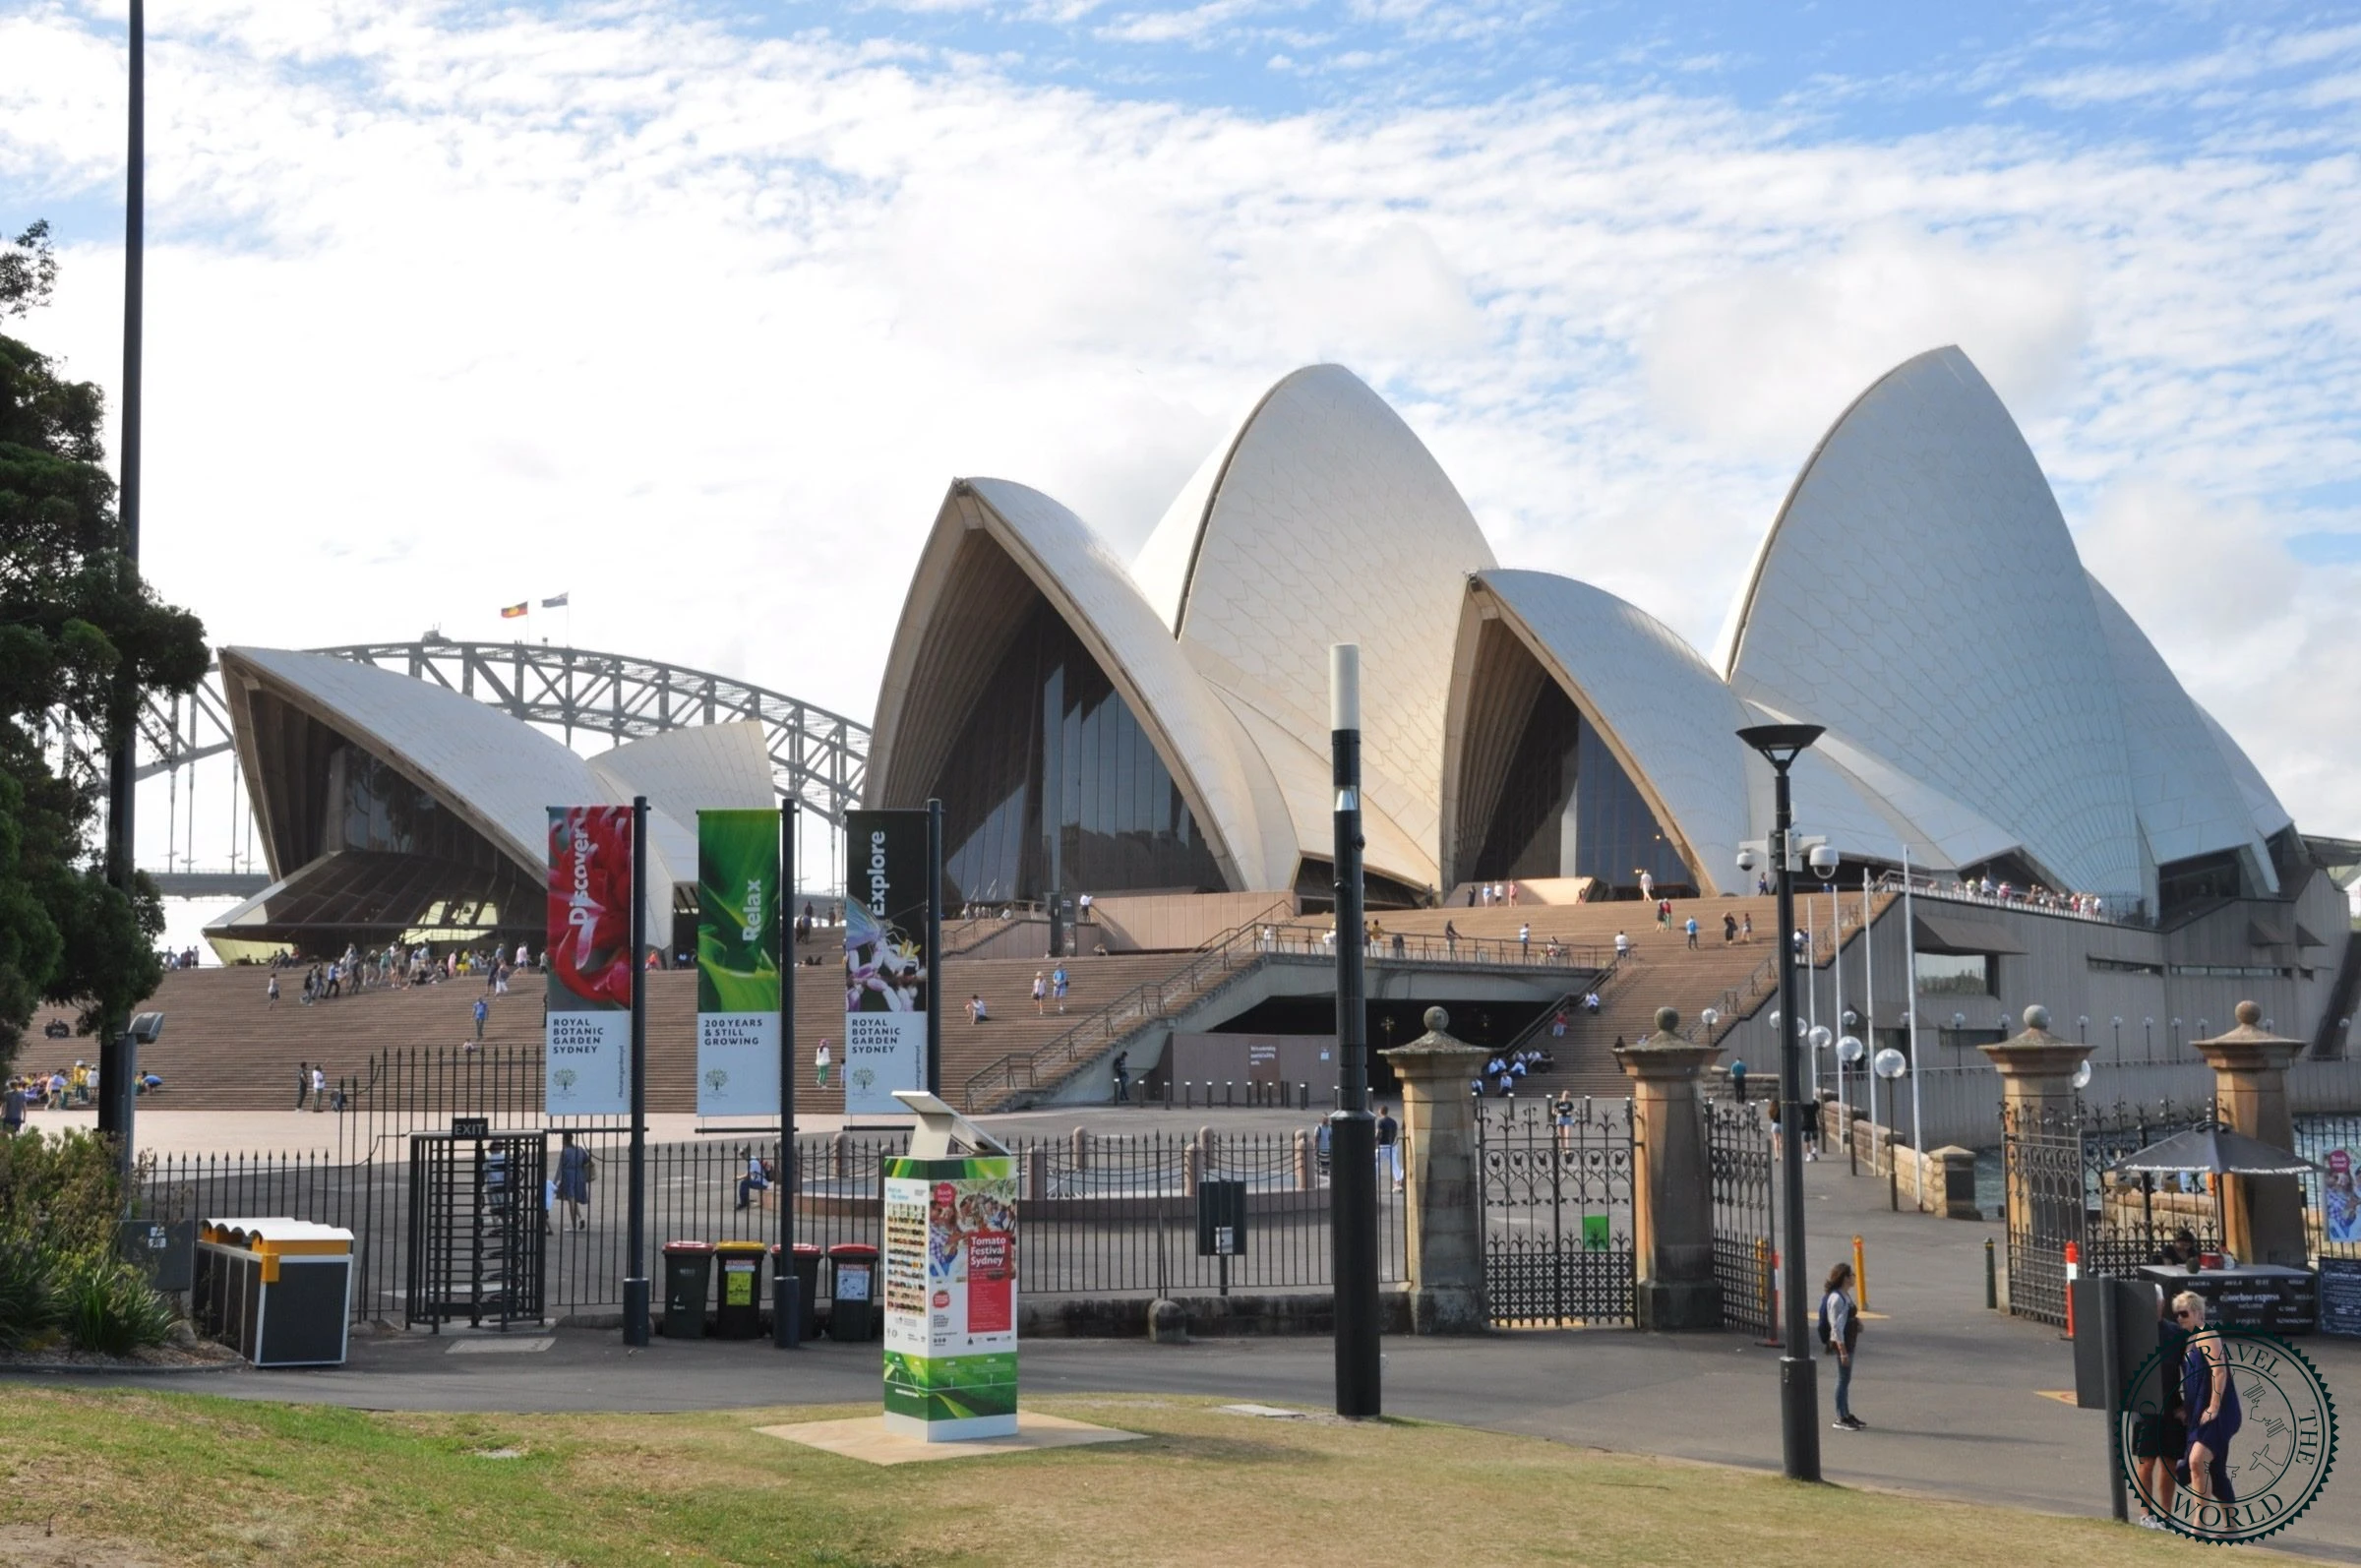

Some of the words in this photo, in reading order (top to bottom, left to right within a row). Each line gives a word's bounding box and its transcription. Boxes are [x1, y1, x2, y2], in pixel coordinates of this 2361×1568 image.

[570, 827, 589, 925] Discover
[867, 830, 890, 917] Explore
[742, 879, 761, 941] Relax
[728, 1018, 762, 1027] YEARS
[553, 1027, 604, 1036] BOTANIC
[704, 1028, 711, 1037] &
[714, 1028, 744, 1037] STILL
[852, 1027, 901, 1036] BOTANIC
[704, 1037, 759, 1046] GROWING
[553, 1045, 597, 1054] SYDNEY
[852, 1045, 895, 1054] SYDNEY
[454, 1123, 484, 1135] EXIT
[971, 1236, 1006, 1245] Tomato
[970, 1244, 1005, 1255] Festival
[970, 1255, 1003, 1267] Sydney
